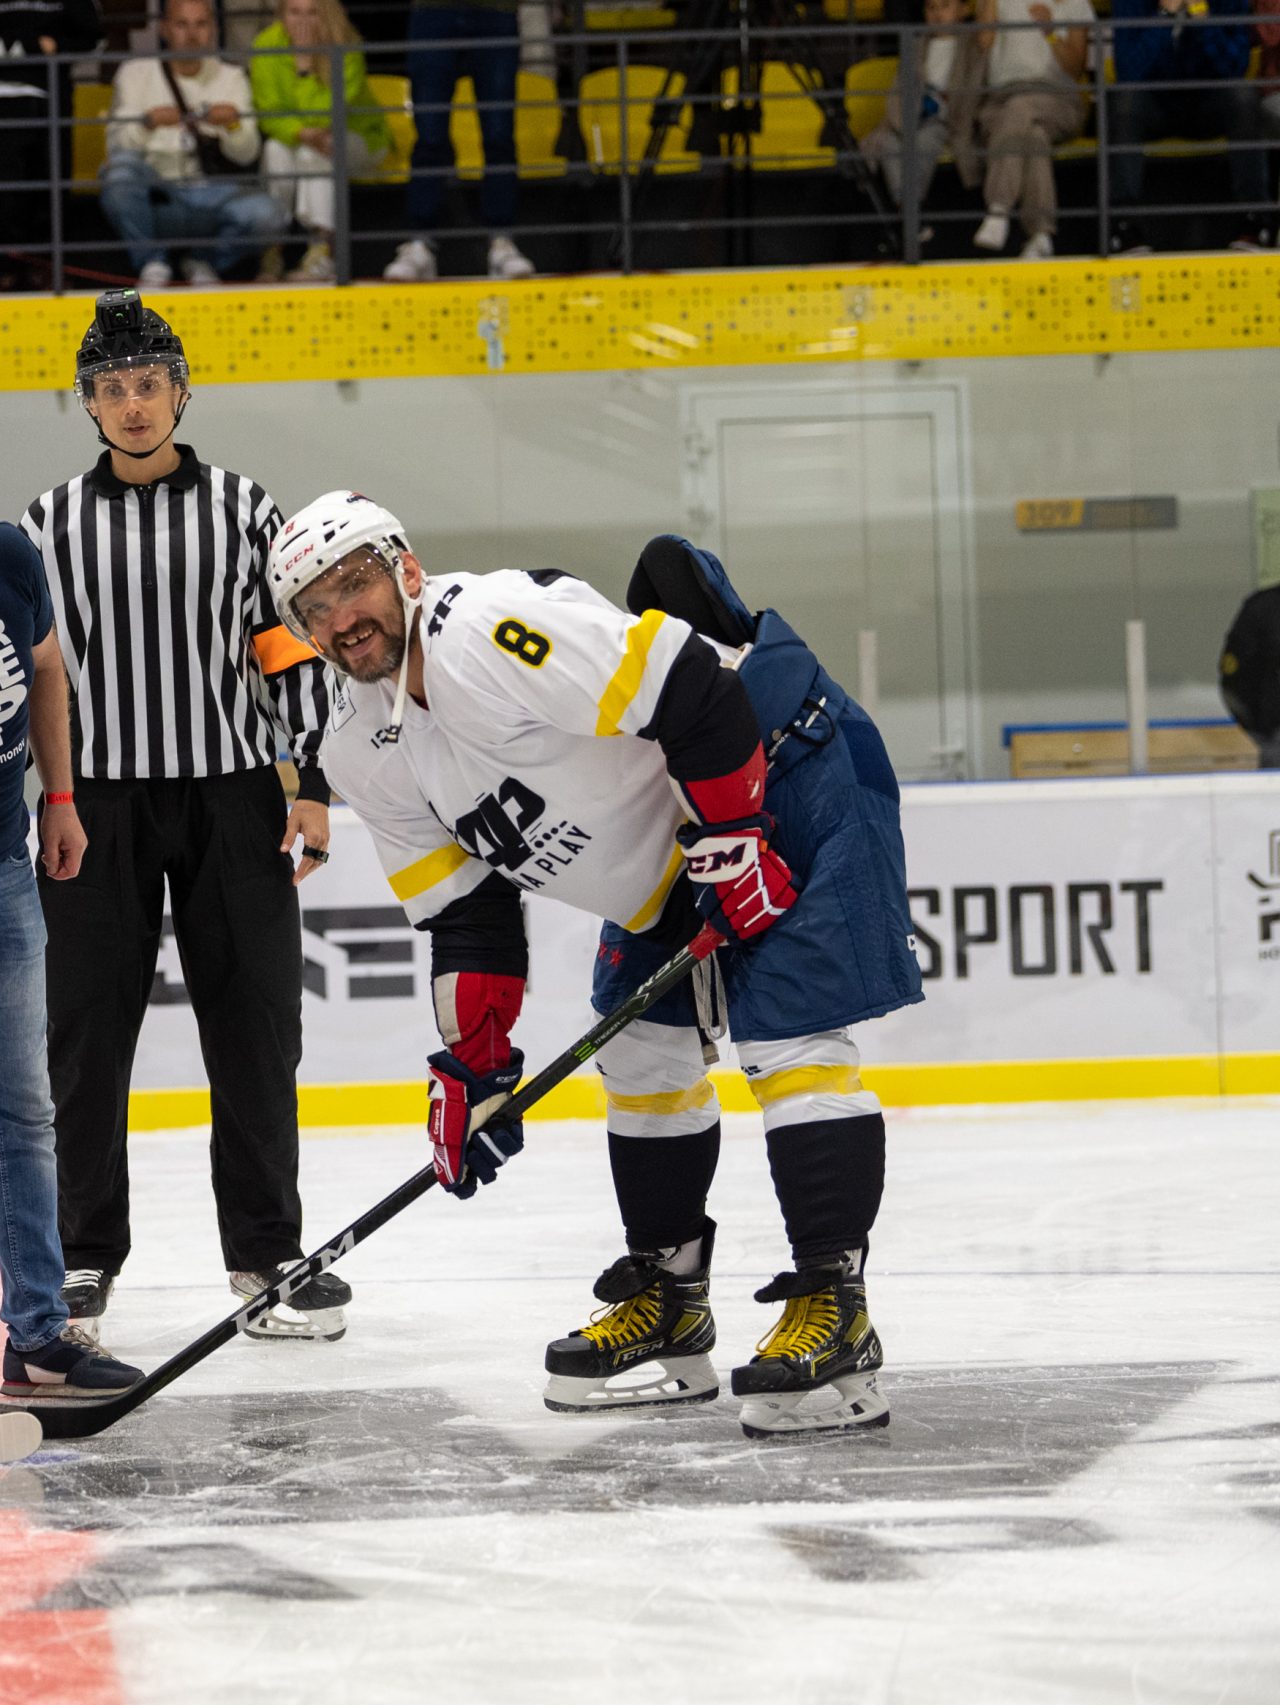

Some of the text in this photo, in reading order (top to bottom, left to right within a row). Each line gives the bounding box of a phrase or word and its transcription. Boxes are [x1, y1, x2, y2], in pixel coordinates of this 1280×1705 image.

[285, 543, 314, 572] CCM
[492, 616, 552, 669] 8
[534, 825, 592, 877] PLAY
[686, 842, 747, 874] CM
[907, 879, 1164, 980] SPORT
[231, 1229, 355, 1333] CCM
[622, 1340, 665, 1362] CCM
